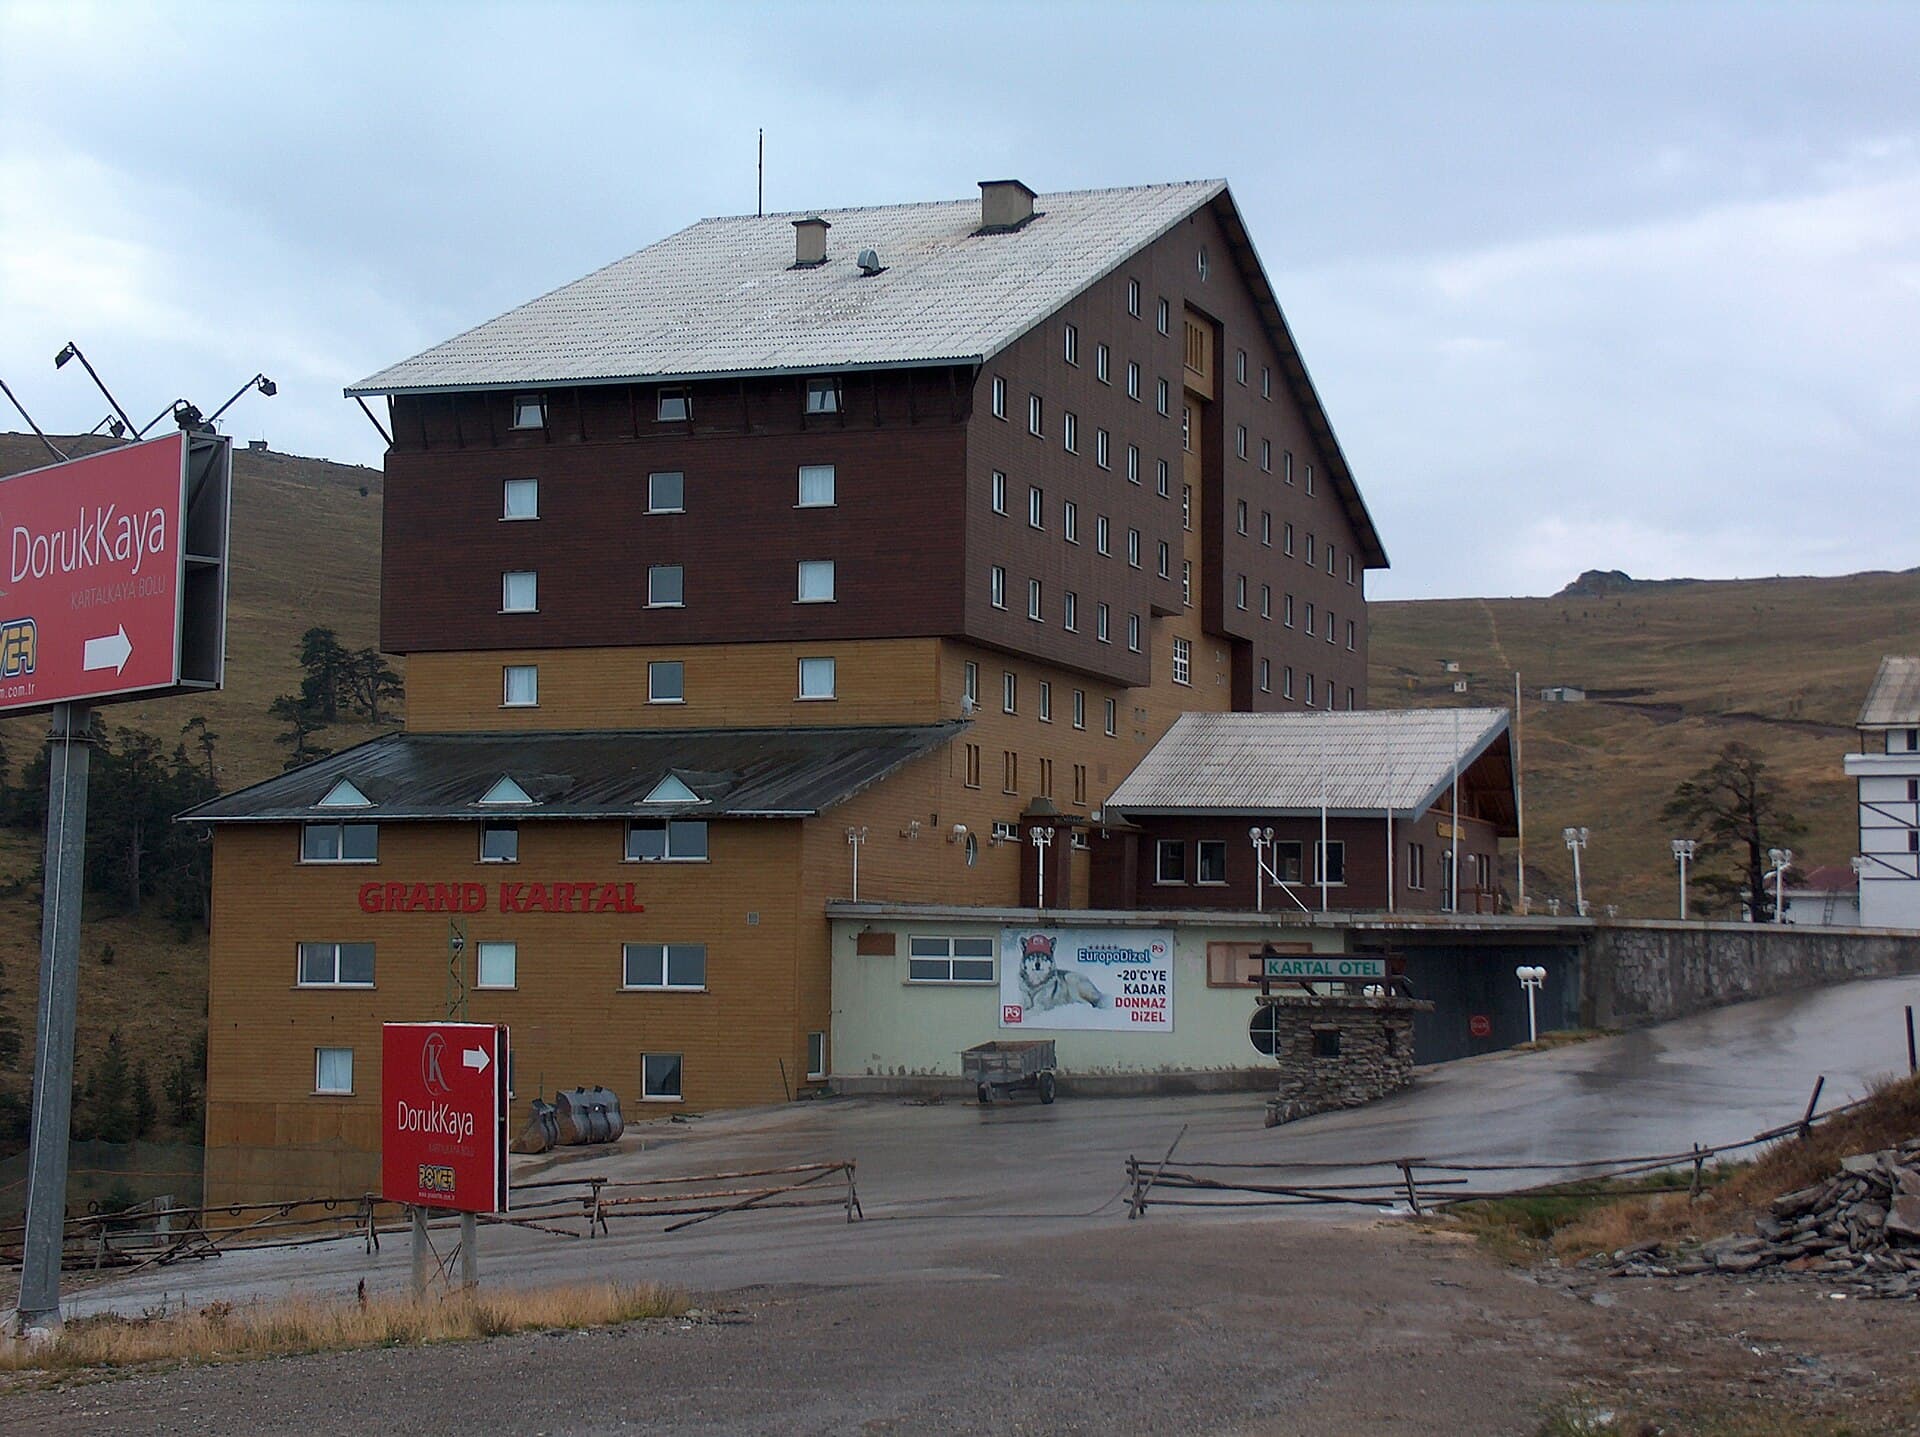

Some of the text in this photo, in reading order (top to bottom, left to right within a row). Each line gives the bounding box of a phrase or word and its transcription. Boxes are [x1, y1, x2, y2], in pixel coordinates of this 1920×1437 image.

[11, 503, 165, 583] DorukKaya
[71, 576, 166, 610] KARTALKAYA BOLU
[358, 882, 644, 913] GRAND KARTAL
[1077, 948, 1151, 966] EuropoDizel
[1268, 961, 1381, 975] KARTAL OTEL
[1115, 997, 1166, 1008] DONMAZ
[1124, 984, 1166, 995] KADAR
[398, 1100, 474, 1143] DorukKaya
[418, 1163, 456, 1192] POWER
